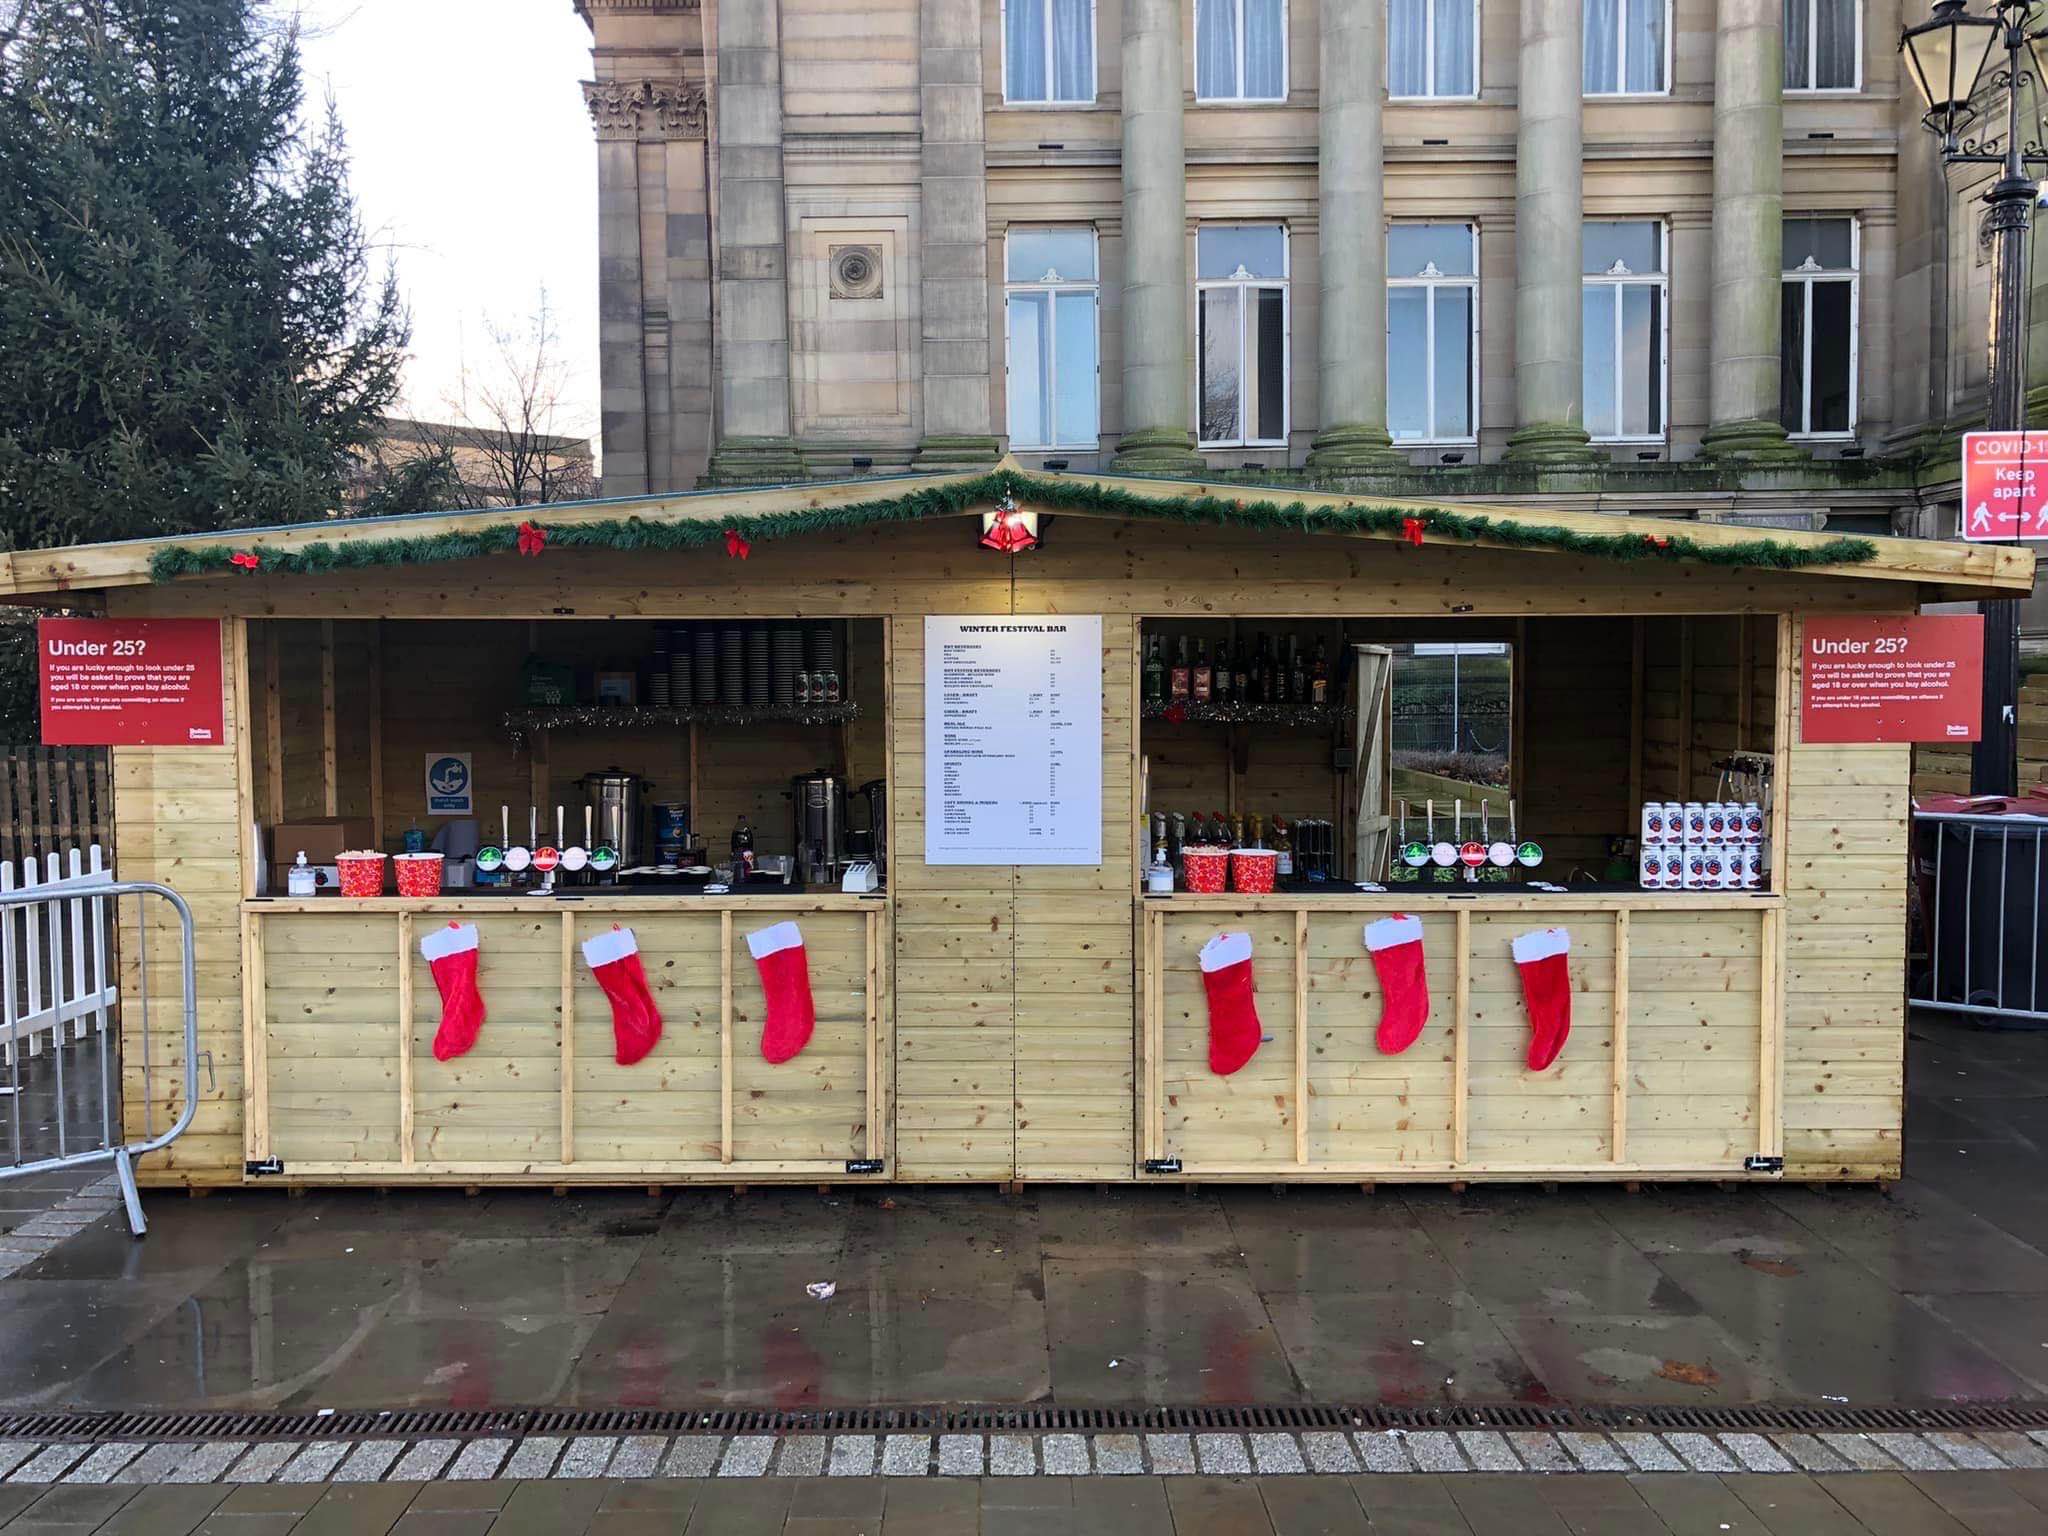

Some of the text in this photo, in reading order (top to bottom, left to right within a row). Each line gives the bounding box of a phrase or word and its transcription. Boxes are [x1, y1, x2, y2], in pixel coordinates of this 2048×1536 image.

[1996, 468, 2035, 483] Keep
[1993, 485, 2036, 500] apart
[49, 640, 146, 656] Under 25?
[1813, 637, 1908, 654] Under 25?
[85, 664, 105, 672] lucky
[106, 664, 135, 672] enough
[1868, 662, 1895, 670] enough
[50, 683, 69, 691] aged
